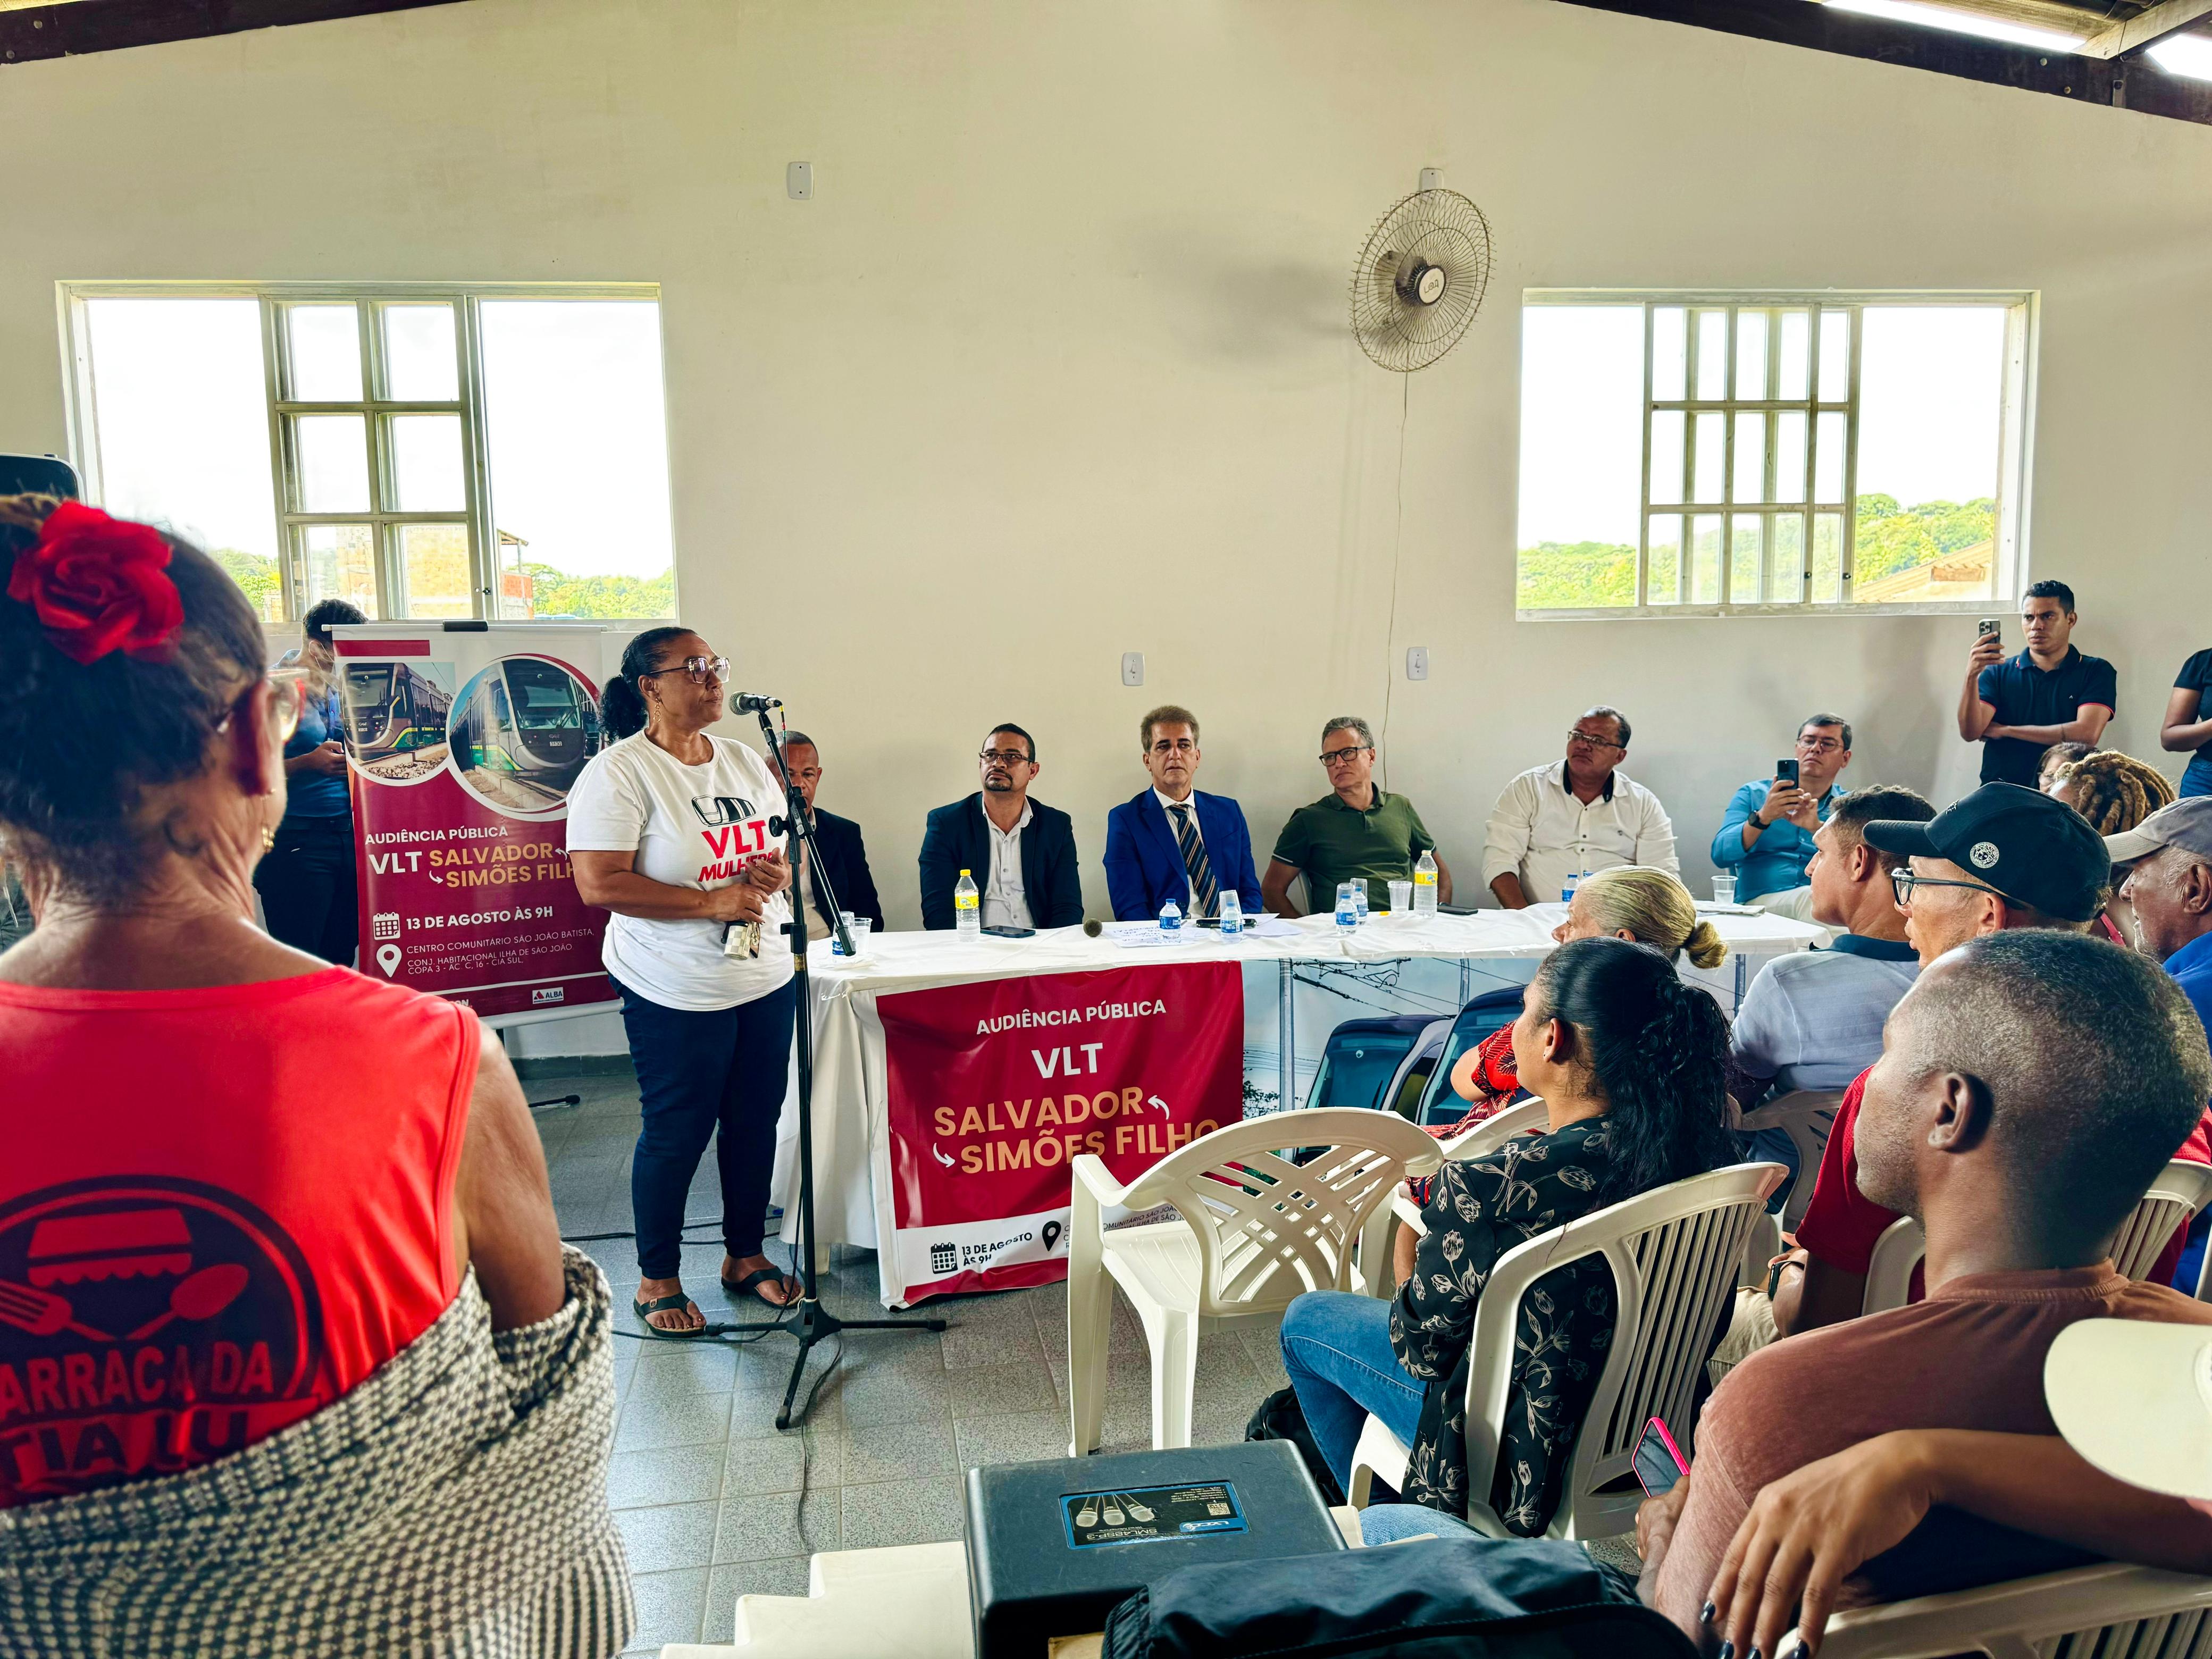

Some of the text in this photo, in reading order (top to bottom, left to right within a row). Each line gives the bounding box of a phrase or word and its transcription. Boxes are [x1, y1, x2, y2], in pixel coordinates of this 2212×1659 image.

[365, 825, 508, 845] AUDIÊNCIA PÚBLICA
[701, 820, 766, 859] VLT
[368, 843, 554, 875] VLT SALVADOR
[446, 864, 532, 888] SIMÕES
[406, 906, 553, 930] 13 DE AGOSTO ÀS 9H
[407, 944, 445, 954] CENTRO
[447, 937, 511, 951] COMUNITÁRIO
[514, 934, 532, 944] SÃO
[534, 931, 559, 942] JOÃO
[407, 958, 435, 967] CONJ.
[438, 952, 497, 965] HABITACIONAL
[532, 945, 548, 954] SÃO
[549, 943, 573, 952] JOÃO
[408, 966, 433, 975] COPA
[545, 990, 563, 999] ALBA
[976, 999, 1167, 1035] AUDIÊNCIA PÚBLICA
[1031, 1042, 1103, 1079] VLT
[934, 1086, 1144, 1136] SALVADOR
[961, 1128, 1105, 1174] SIMÕES
[1104, 1214, 1145, 1230] OMUNITÁRIO
[1145, 1210, 1159, 1218] SÃO
[1161, 1212, 1176, 1221] SÃO
[961, 1232, 1033, 1255] 13 DE AGOSTO
[963, 1254, 992, 1267] ÀS 9H
[210, 1340, 274, 1396] DA
[0, 1421, 130, 1489] TIA
